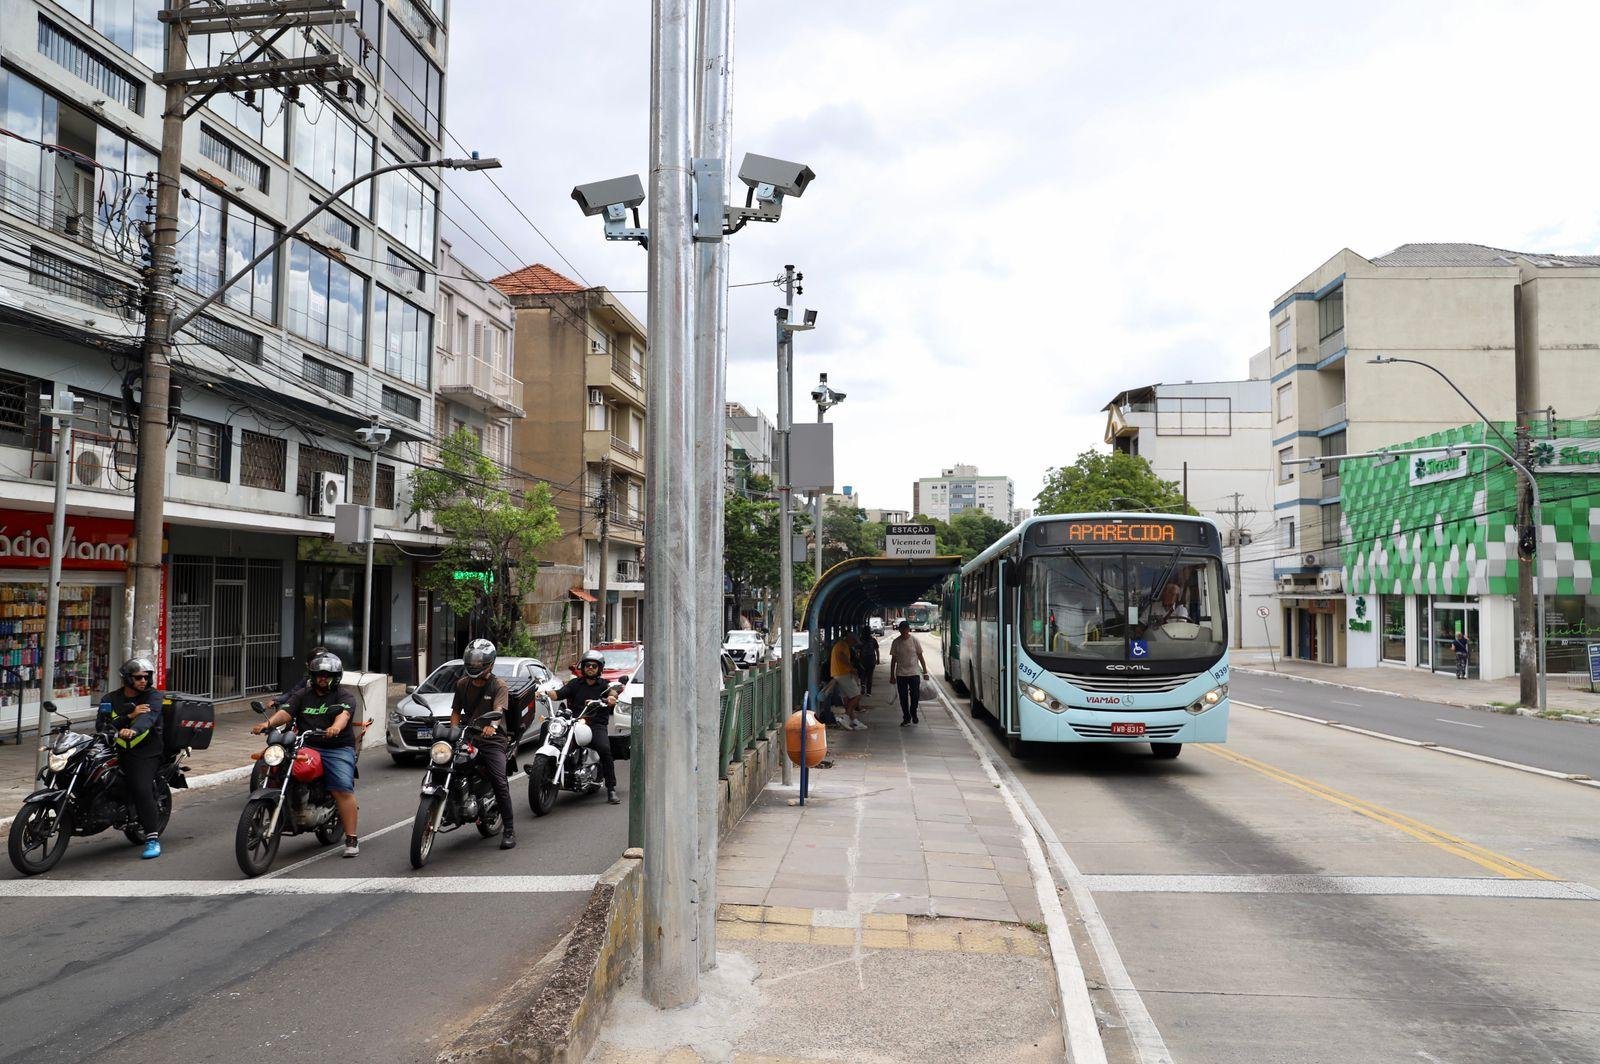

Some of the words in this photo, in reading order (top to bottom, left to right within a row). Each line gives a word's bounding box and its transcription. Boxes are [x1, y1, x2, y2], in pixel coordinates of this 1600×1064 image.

[892, 525, 930, 535] ESTAÇÃO
[1069, 524, 1174, 541] APARECIDA
[891, 538, 921, 546] Vicente
[921, 538, 931, 546] da
[895, 547, 931, 555] Fontoura
[1018, 662, 1037, 679] 8391
[1086, 696, 1120, 704] VIAMÃO
